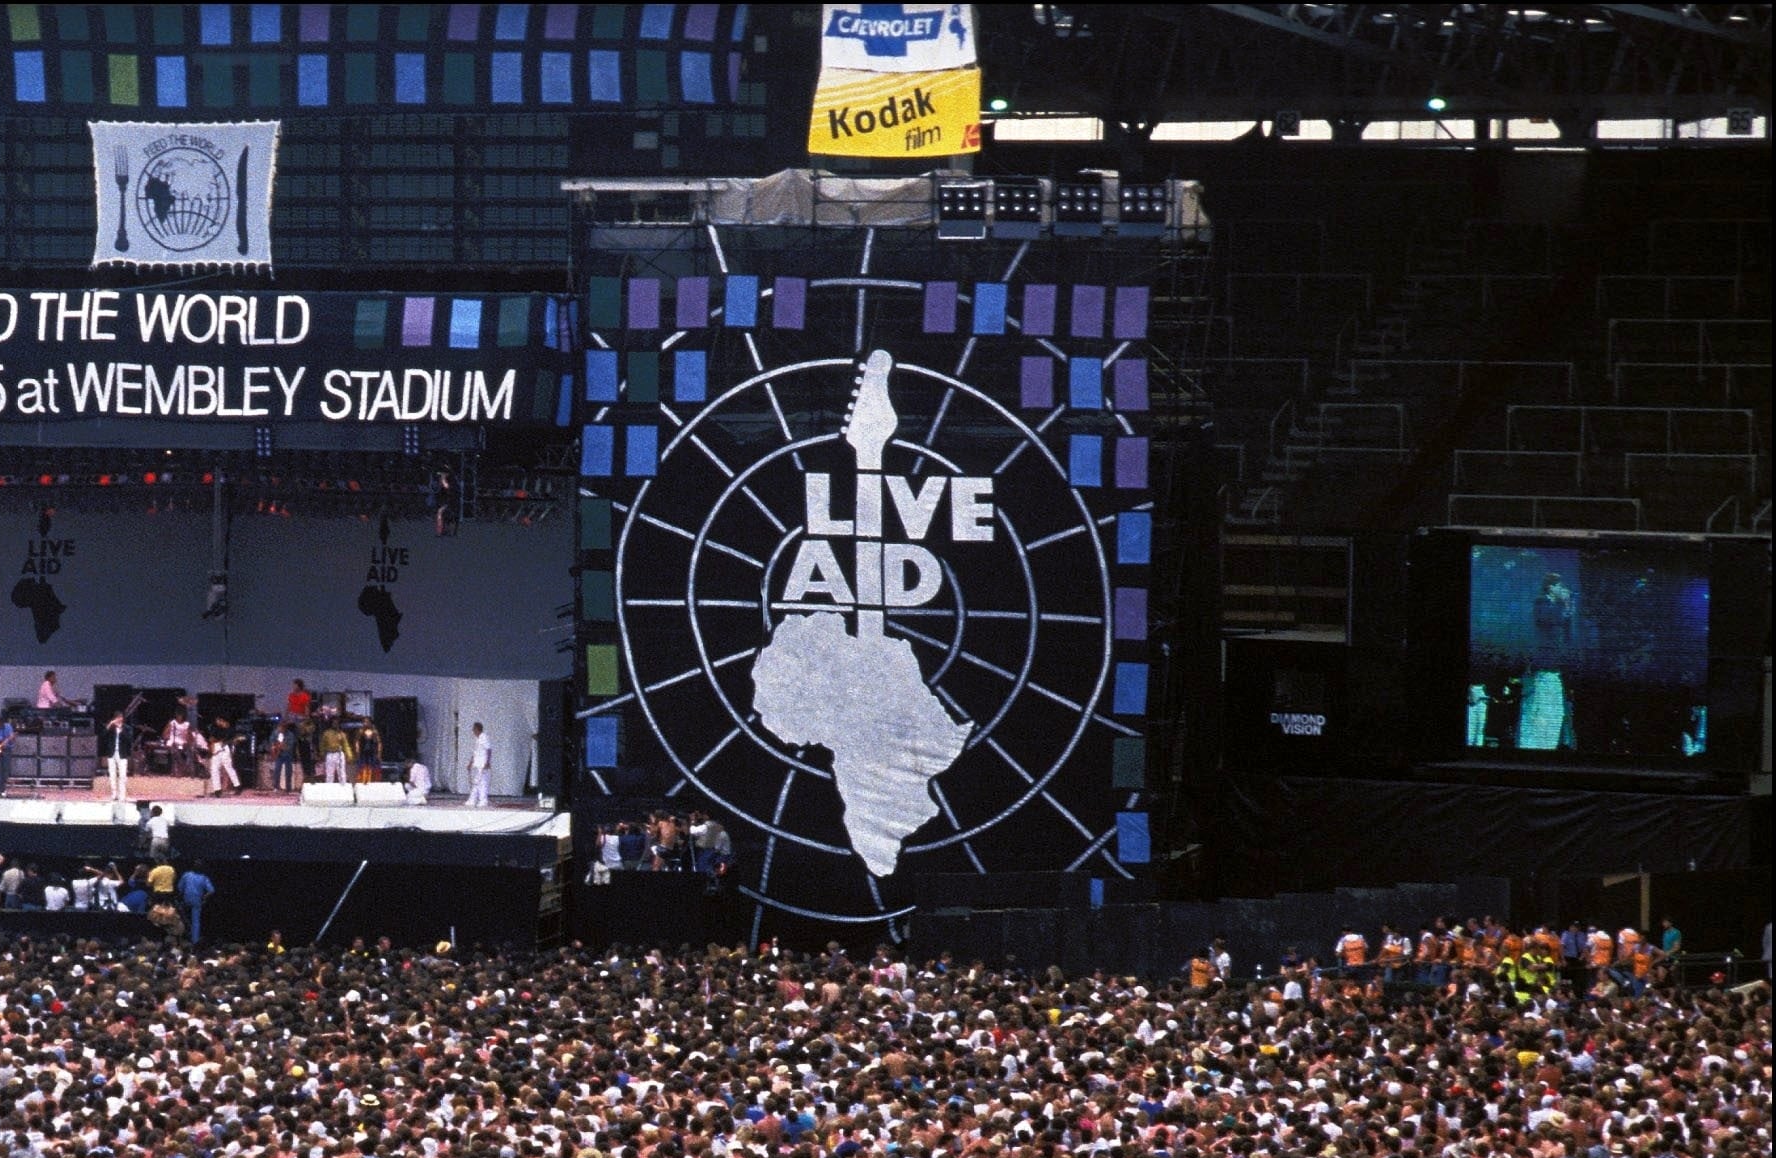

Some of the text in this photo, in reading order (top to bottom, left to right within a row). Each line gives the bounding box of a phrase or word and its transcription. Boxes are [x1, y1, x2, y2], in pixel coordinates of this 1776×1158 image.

[828, 88, 935, 139] Kodak
[1278, 112, 1296, 132] 62
[1731, 110, 1750, 131] 65
[143, 134, 224, 160] FEED THE WORLD
[905, 125, 942, 152] film
[30, 290, 120, 342] THE
[135, 292, 310, 346] WORLD
[17, 368, 59, 415] at
[67, 362, 306, 416] WEMBLEY
[320, 367, 517, 420] STADIUM
[805, 473, 995, 541] LIVE
[28, 540, 75, 557] LIVE
[371, 547, 409, 566] LIVE
[21, 558, 62, 574] AID
[366, 566, 398, 582] AID
[782, 540, 943, 607] AID
[1271, 713, 1326, 725] DIAMOND
[1282, 724, 1322, 735] VISION
